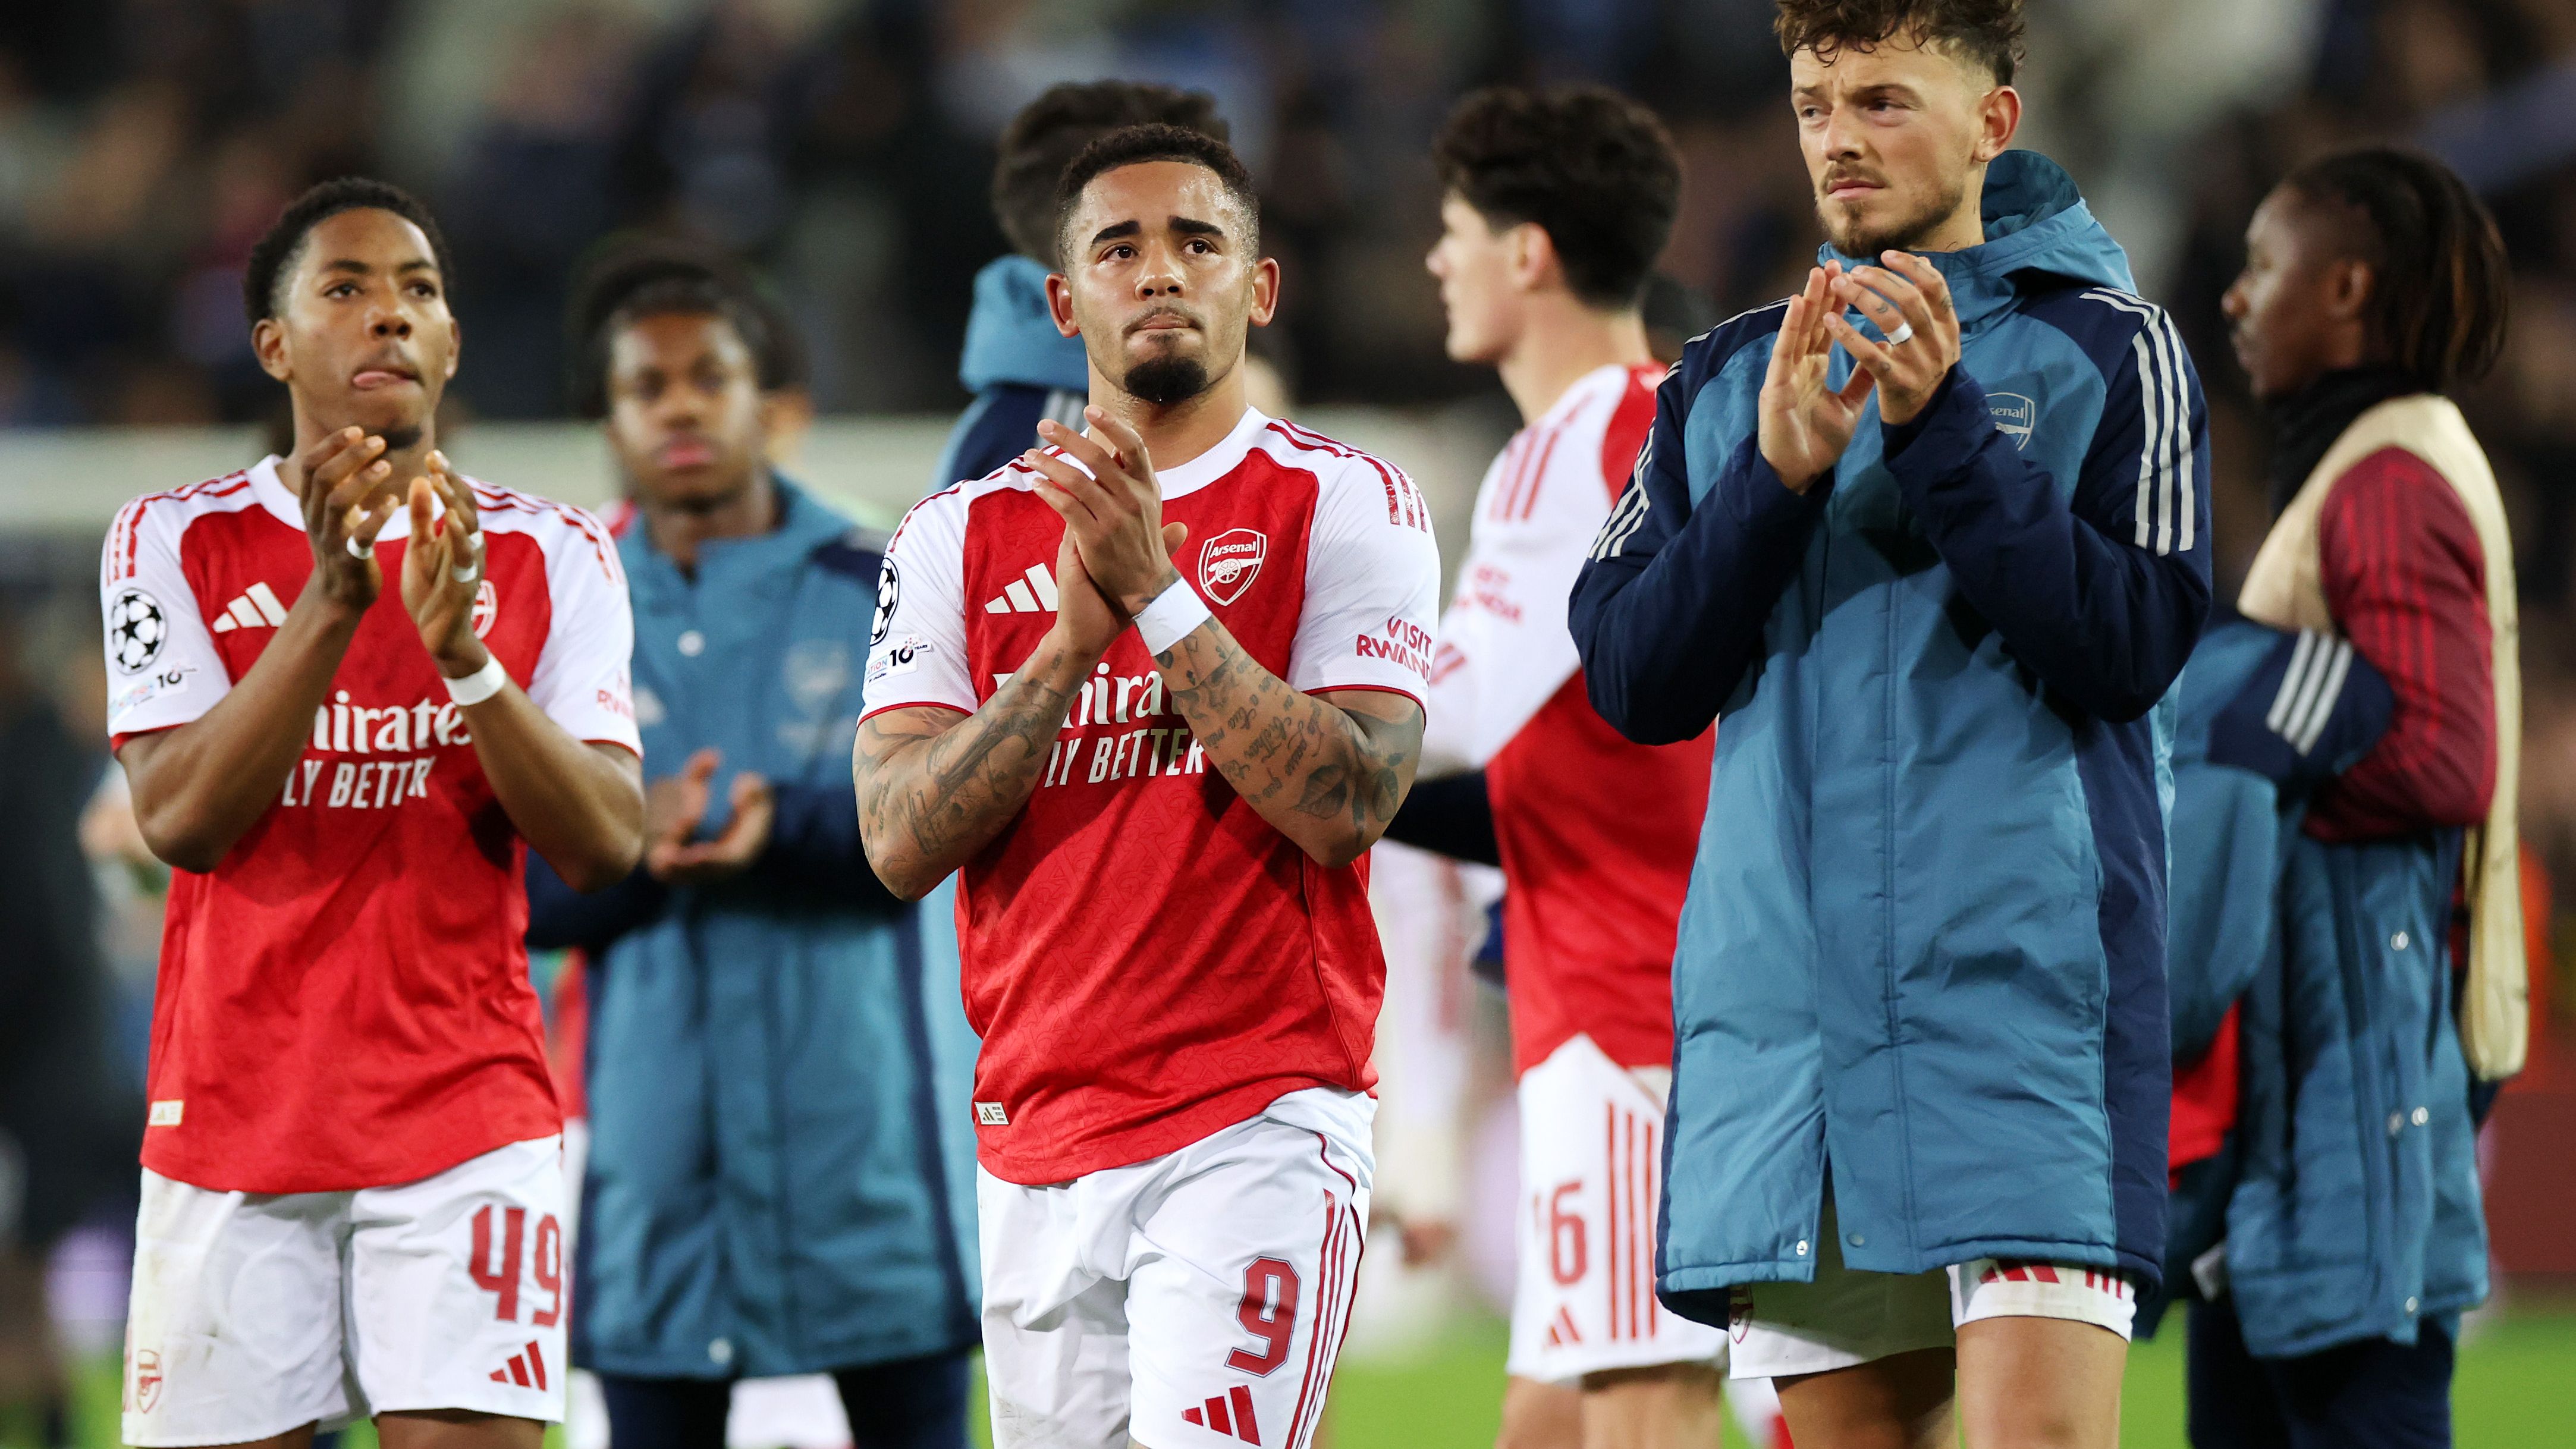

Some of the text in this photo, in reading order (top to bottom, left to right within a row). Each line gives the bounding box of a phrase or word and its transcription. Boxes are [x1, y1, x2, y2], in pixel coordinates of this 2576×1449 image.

[1988, 407, 2024, 419] senal
[1209, 541, 1256, 558] Arsenal
[889, 648, 914, 667] 10
[1387, 615, 1432, 658] VISIT
[157, 670, 182, 688] 10
[281, 755, 436, 809] LY BETTR
[1044, 738, 1082, 788] LY
[468, 1205, 561, 1328] 49
[1224, 1255, 1301, 1378] 9
